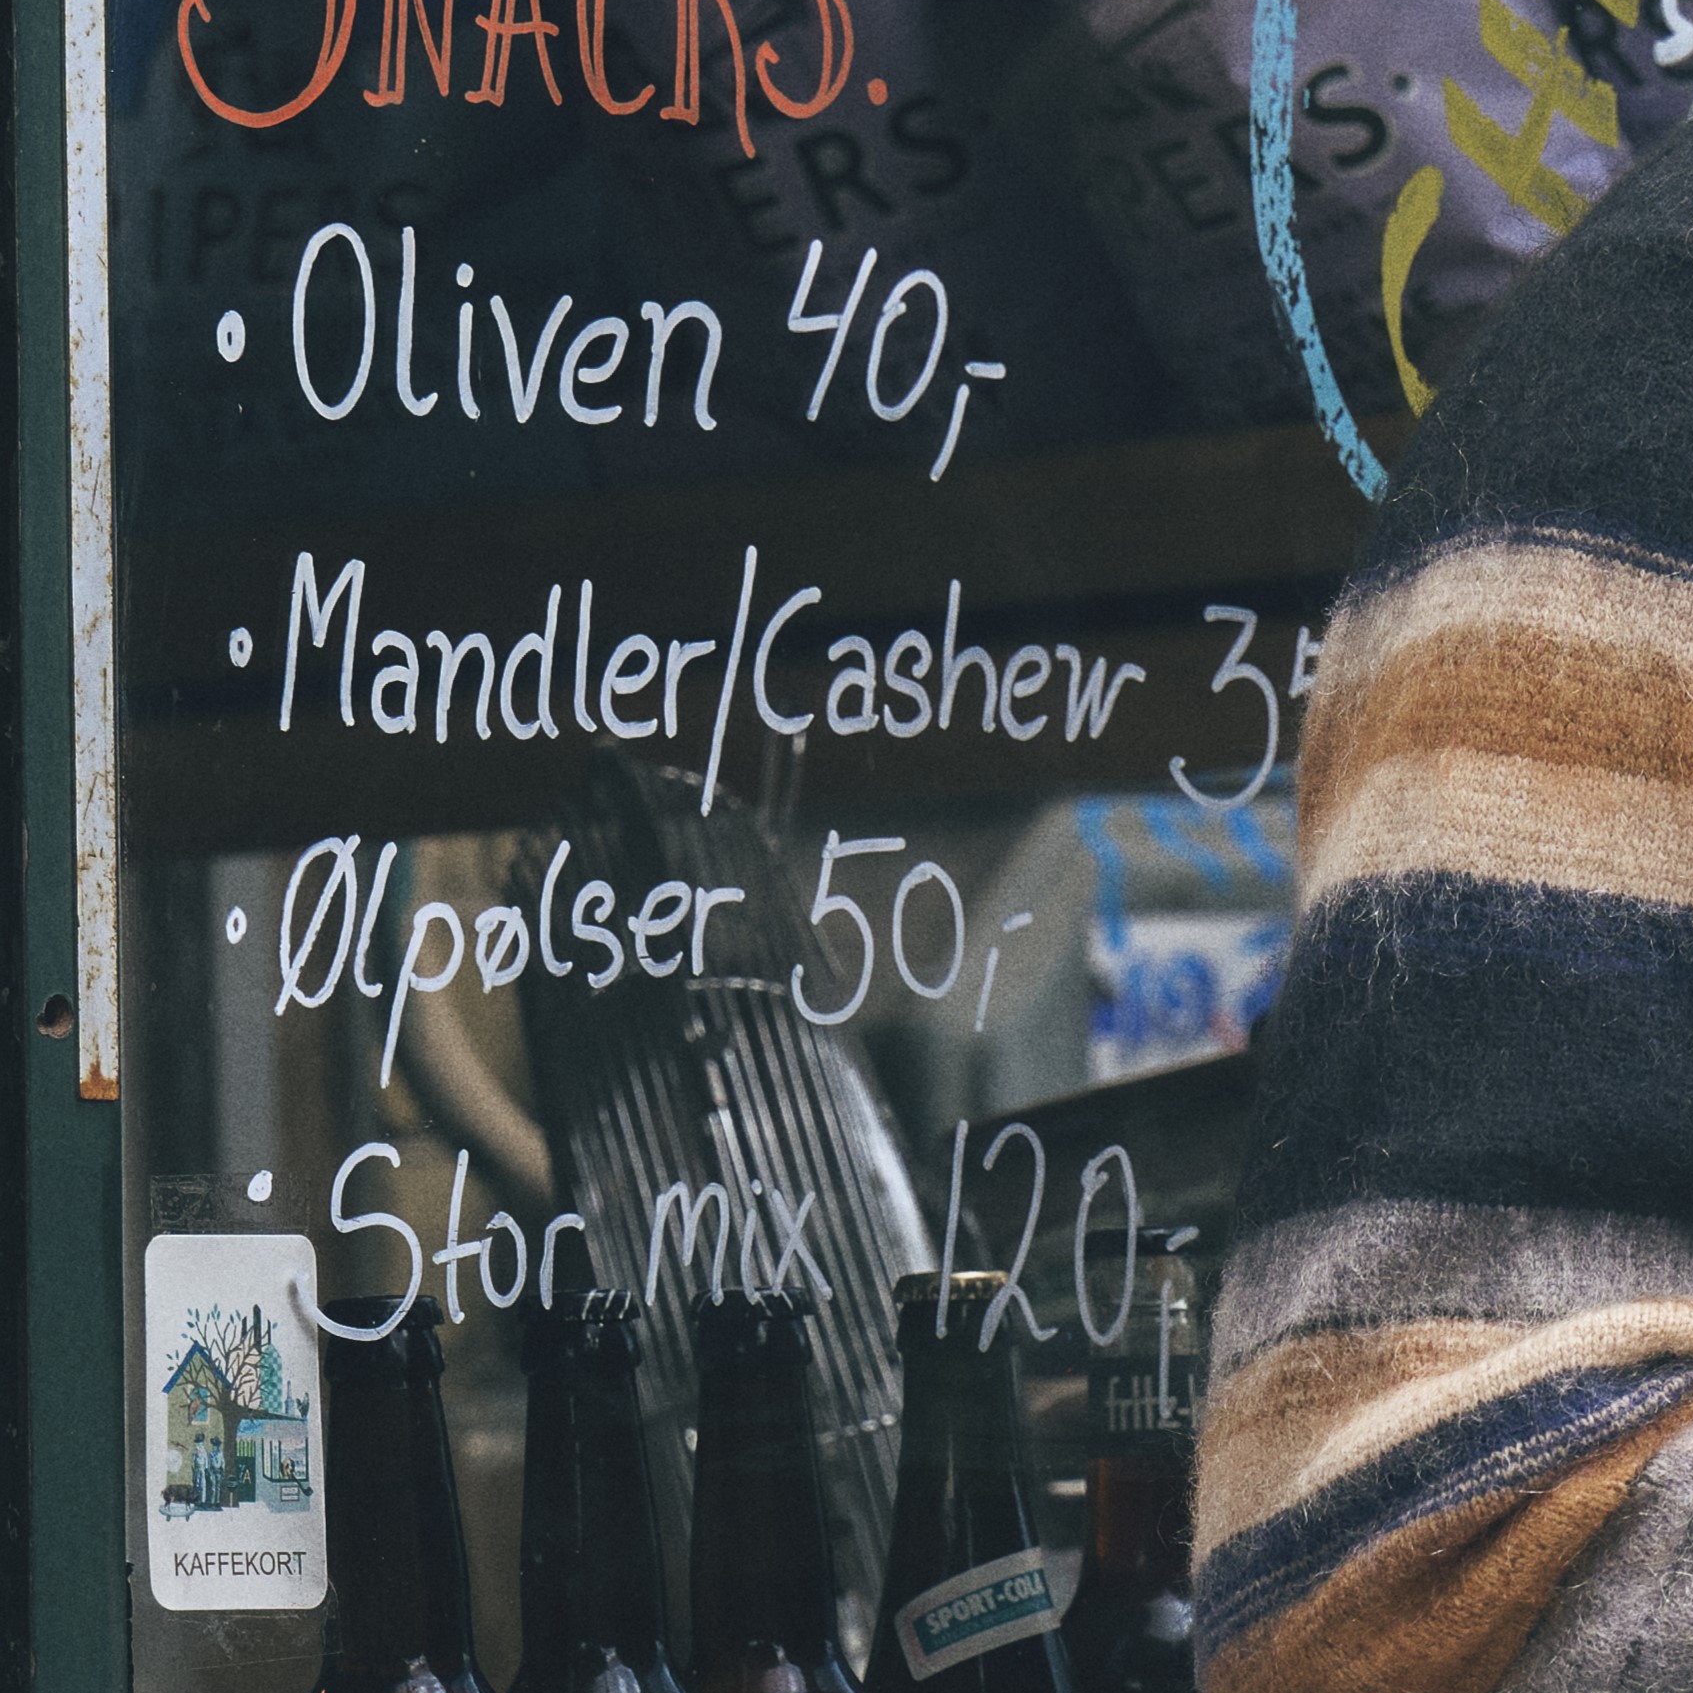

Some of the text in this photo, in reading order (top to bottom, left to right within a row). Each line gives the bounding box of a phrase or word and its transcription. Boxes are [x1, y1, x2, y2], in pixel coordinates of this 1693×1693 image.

[292, 222, 720, 431] Oliven
[274, 833, 745, 1089] Ølpølser
[296, 1141, 587, 1342] Stor
[645, 1180, 833, 1307] mix
[173, 1551, 307, 1577] KAFFEKORT
